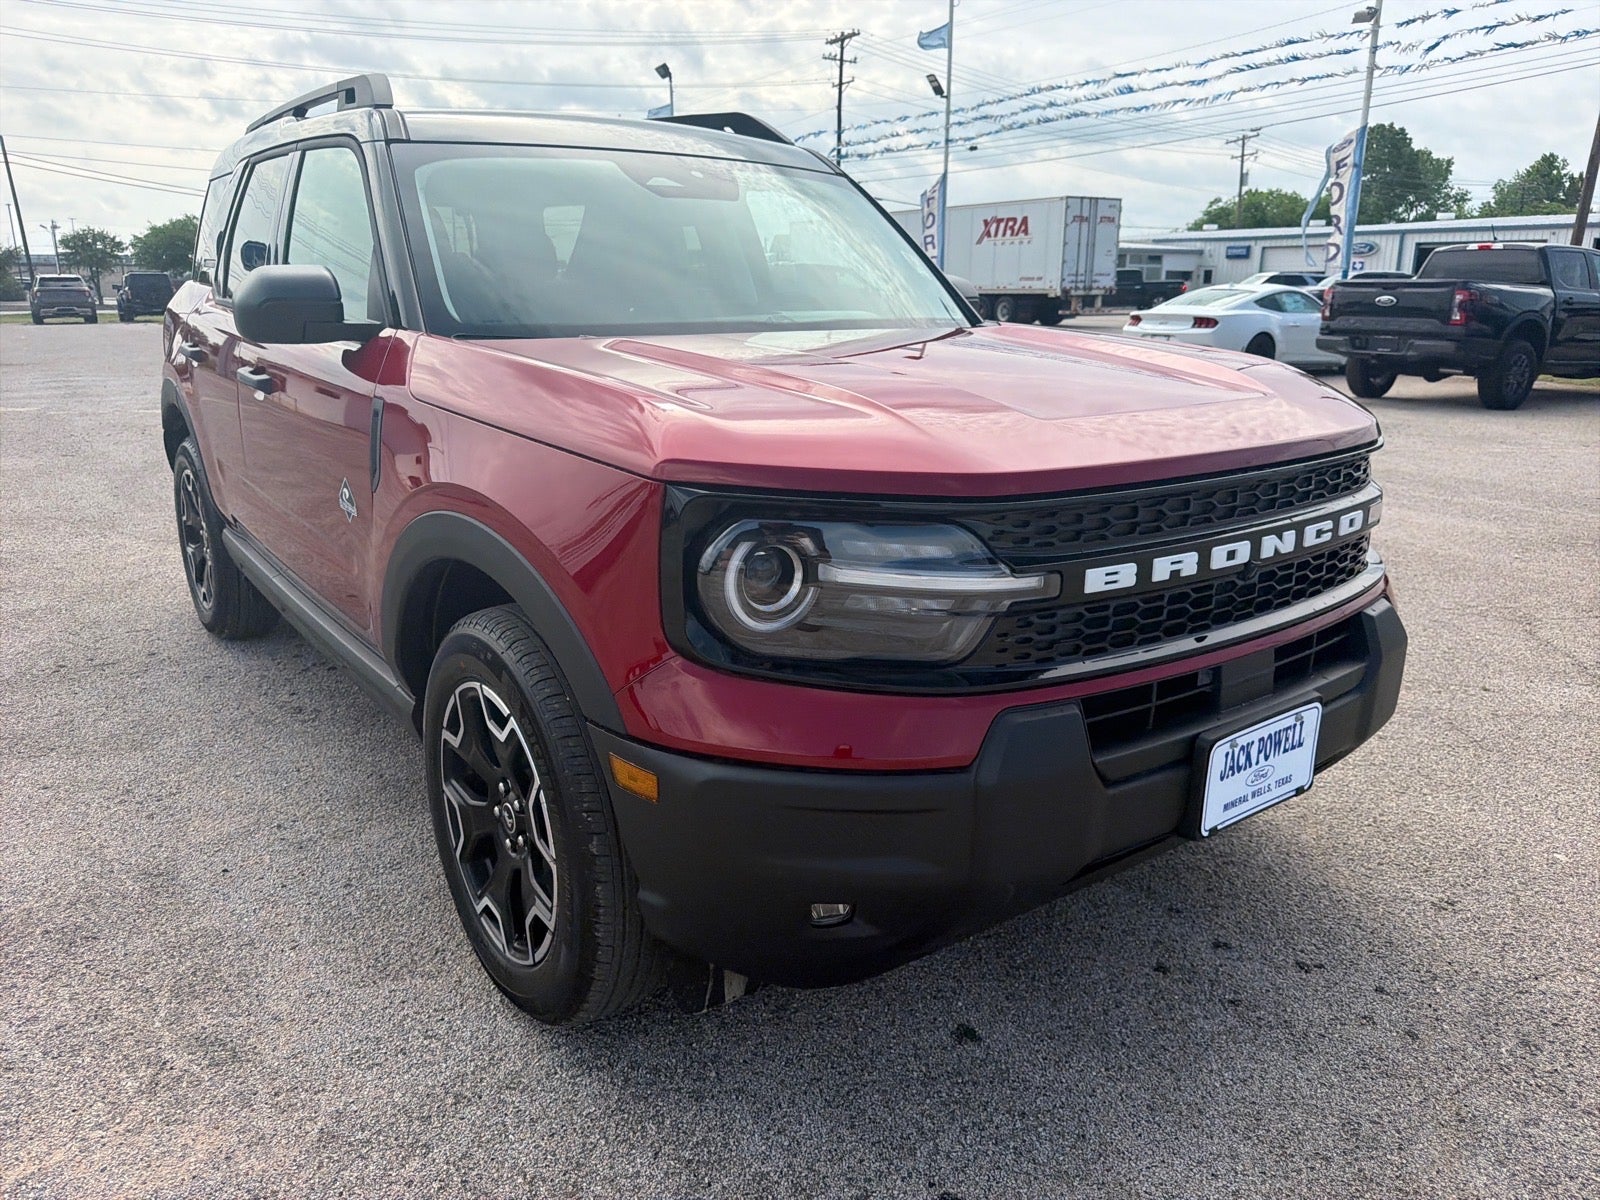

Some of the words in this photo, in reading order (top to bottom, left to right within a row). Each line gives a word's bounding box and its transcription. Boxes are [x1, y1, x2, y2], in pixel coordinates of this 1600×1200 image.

[923, 189, 938, 260] FOR
[976, 216, 1029, 245] XTRA
[1326, 153, 1351, 262] FORD
[1084, 510, 1364, 594] BRONCO
[1220, 740, 1254, 782] JACK
[1255, 721, 1305, 766] POWELL
[1250, 768, 1270, 784] Ford
[1223, 793, 1249, 813] MINERAL
[1274, 774, 1293, 789] TEXAS
